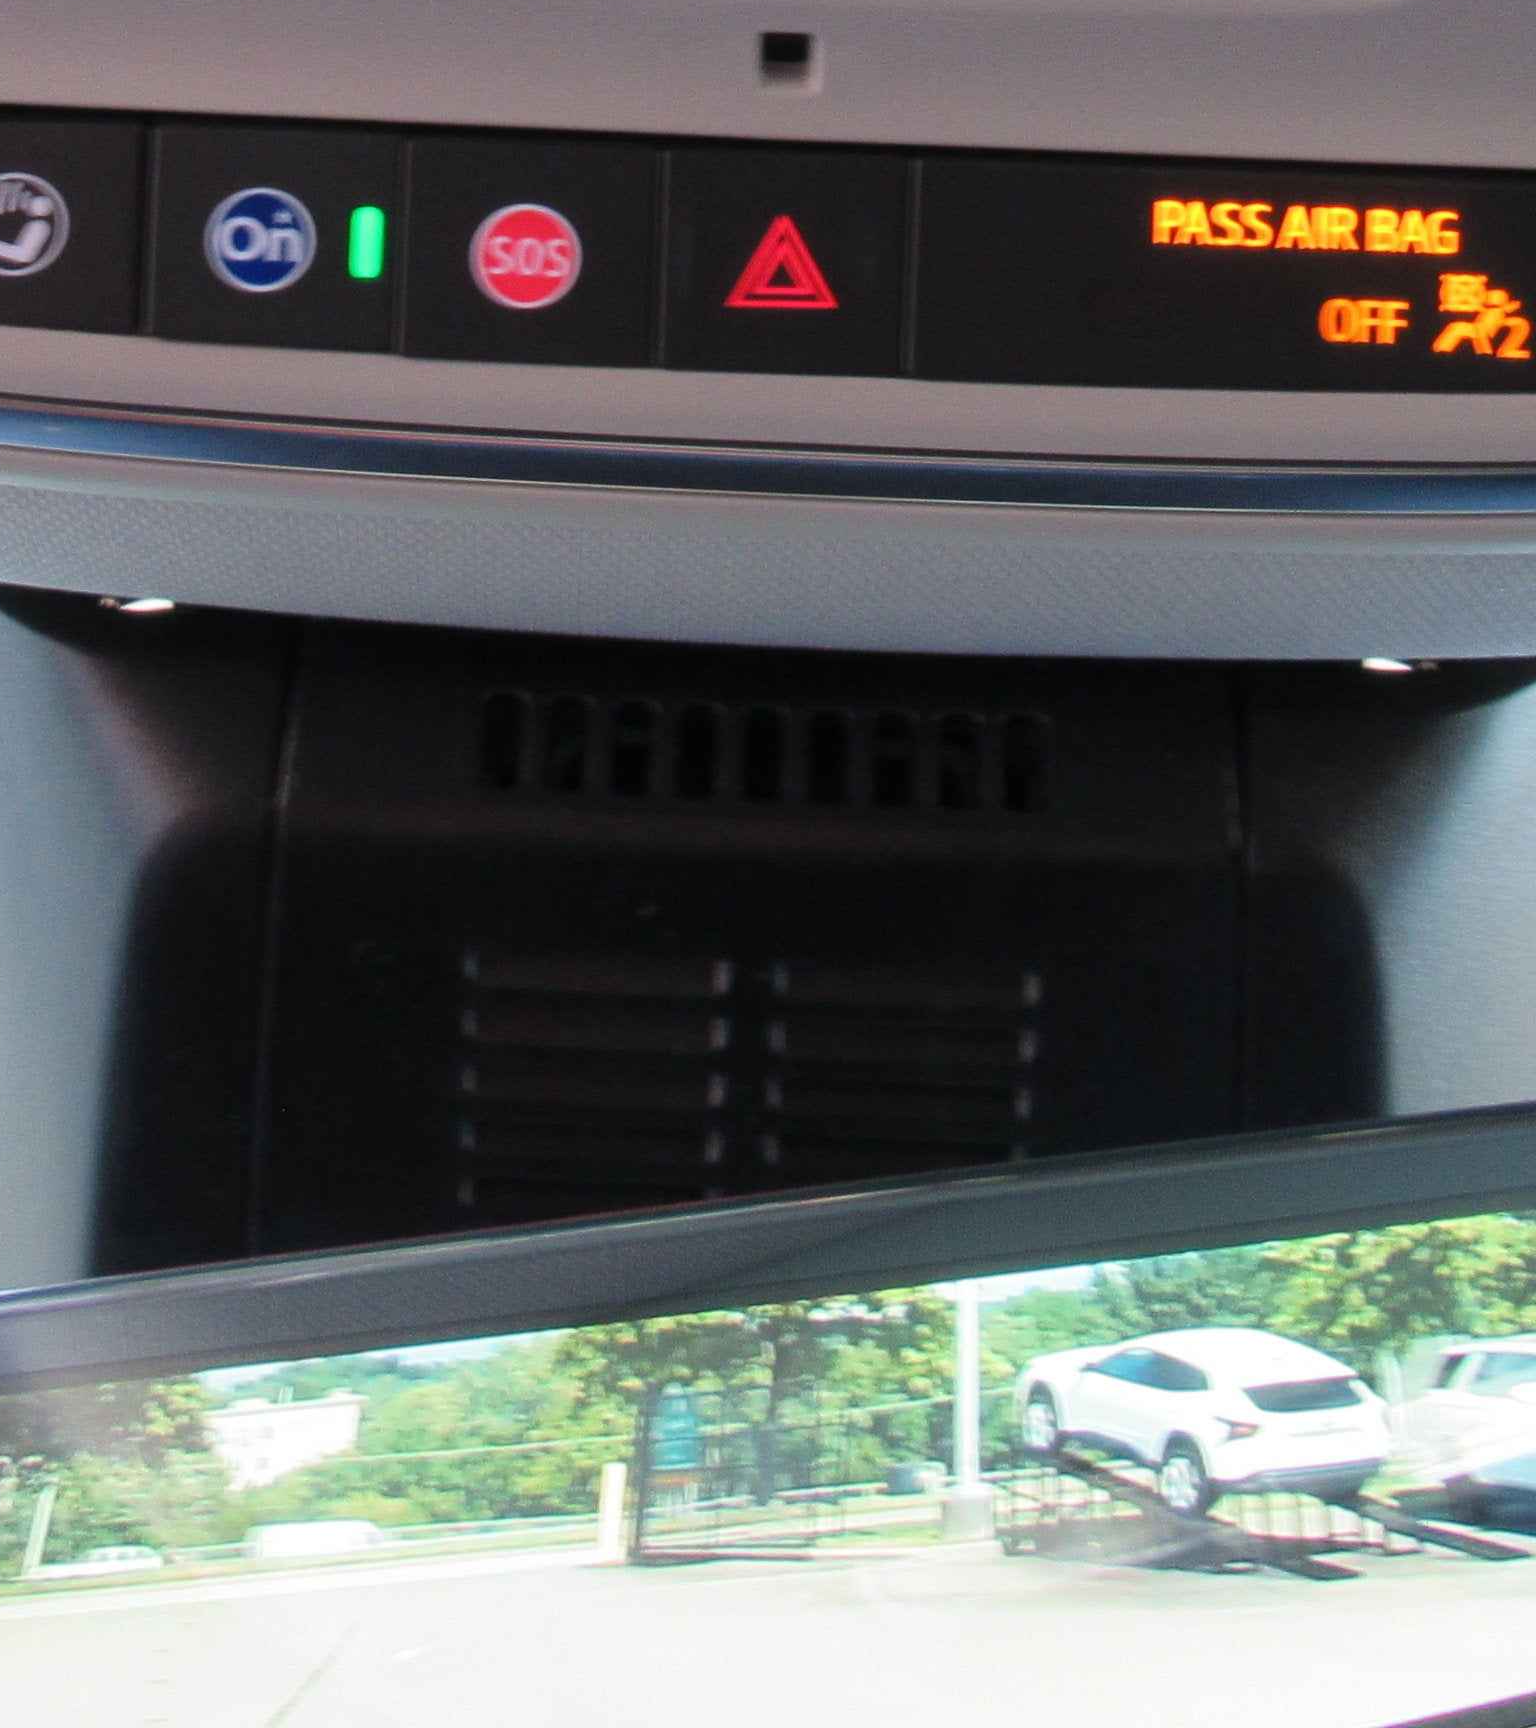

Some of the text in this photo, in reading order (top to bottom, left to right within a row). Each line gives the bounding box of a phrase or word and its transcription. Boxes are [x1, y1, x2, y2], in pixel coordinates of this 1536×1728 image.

[1151, 198, 1460, 255] PASS AIR BAG
[485, 235, 570, 277] SOS
[1317, 297, 1411, 345] OFF
